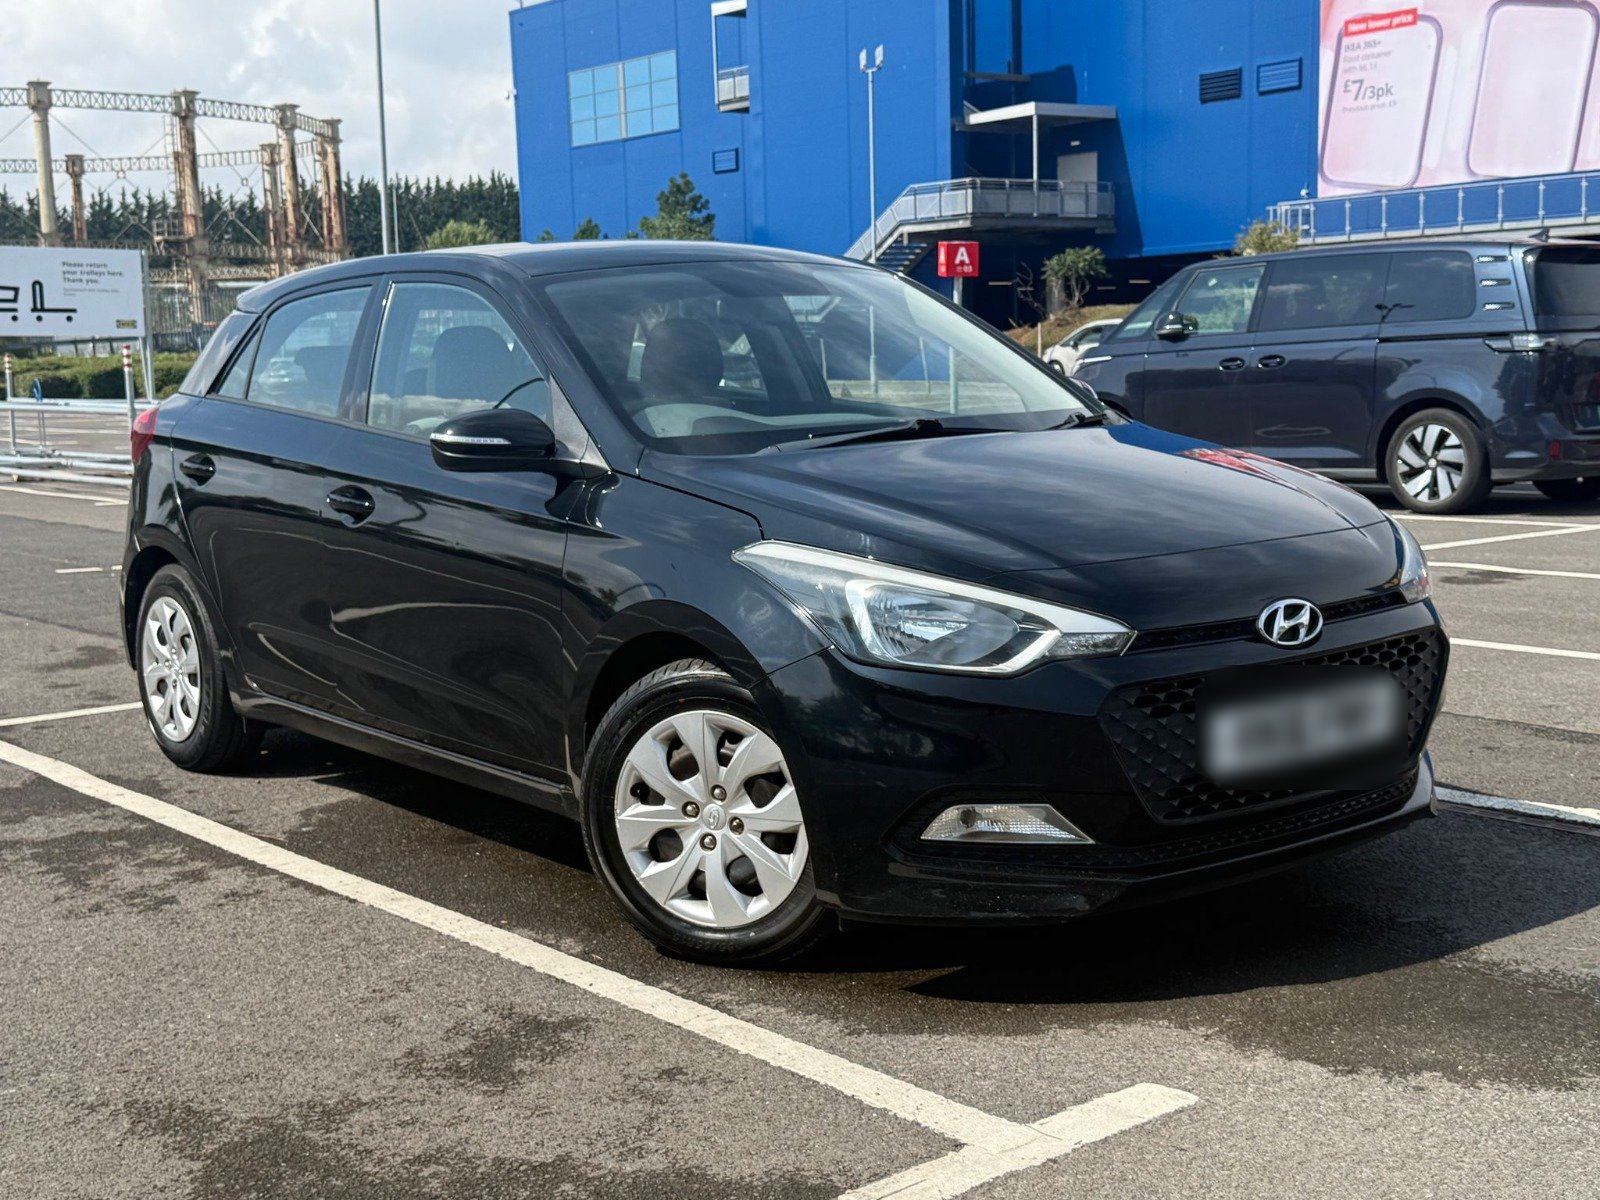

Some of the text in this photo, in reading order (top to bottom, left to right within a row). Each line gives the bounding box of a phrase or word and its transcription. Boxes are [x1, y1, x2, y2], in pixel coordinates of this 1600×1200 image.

[1347, 13, 1414, 33] New lower price
[1344, 42, 1361, 52] IKEA
[1343, 78, 1394, 101] £7/3pk
[954, 246, 970, 265] A
